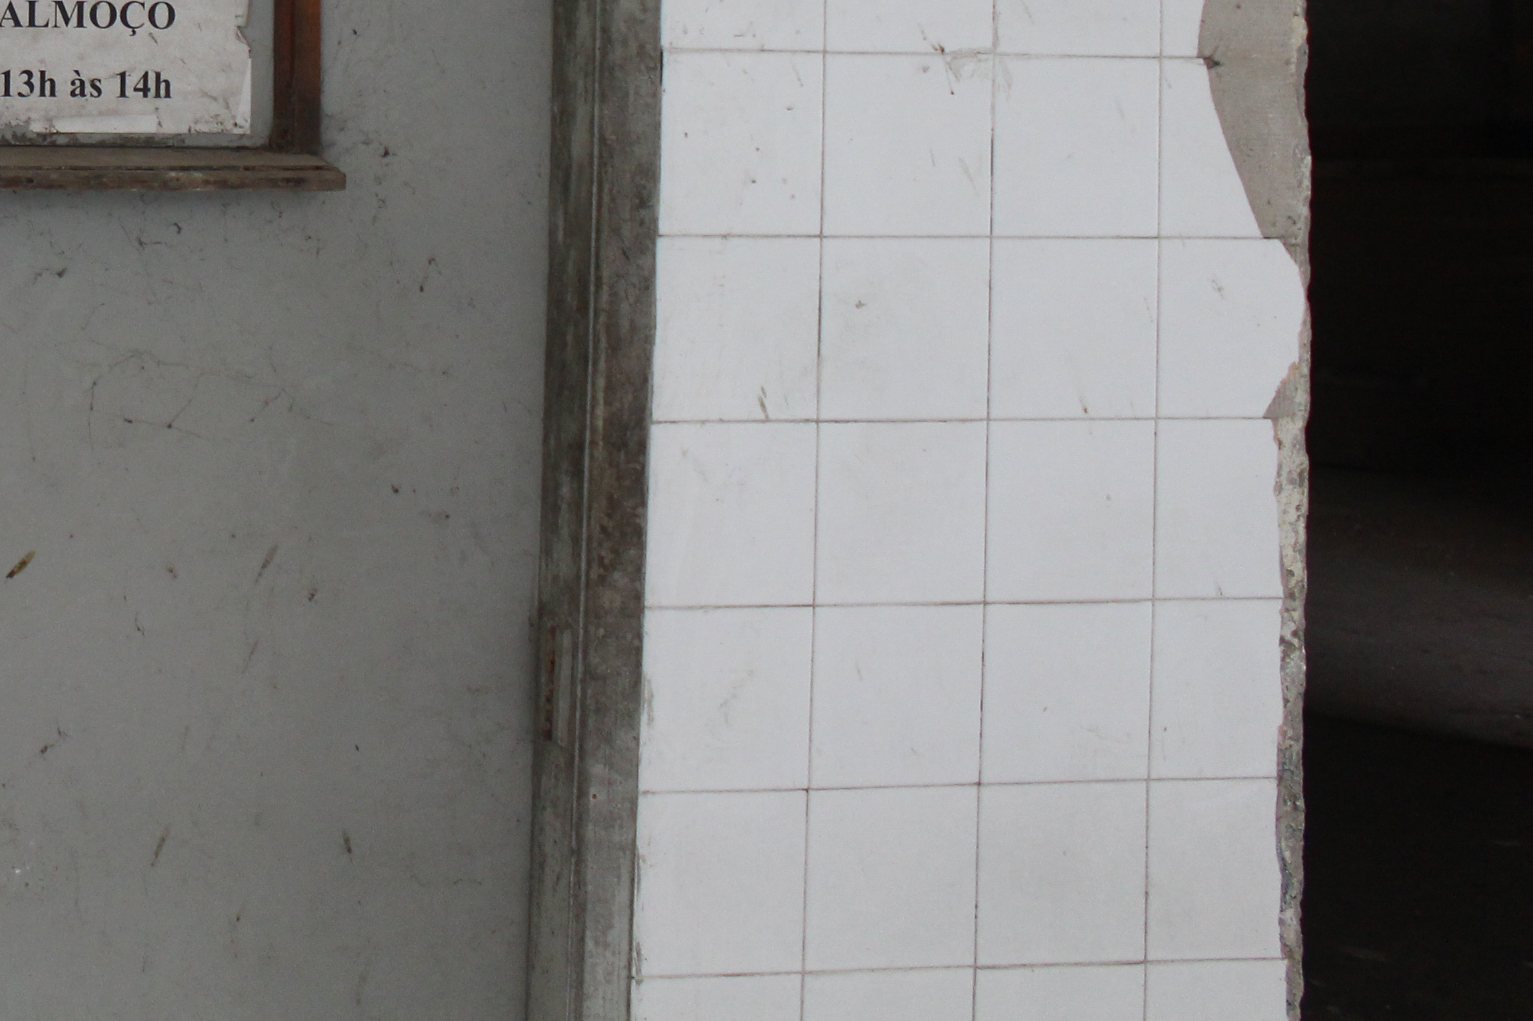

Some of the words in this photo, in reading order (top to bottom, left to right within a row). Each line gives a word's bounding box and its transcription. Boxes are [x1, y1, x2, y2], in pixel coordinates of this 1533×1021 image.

[0, 69, 57, 99] 13h
[69, 68, 103, 99] às
[116, 70, 173, 99] 14h
